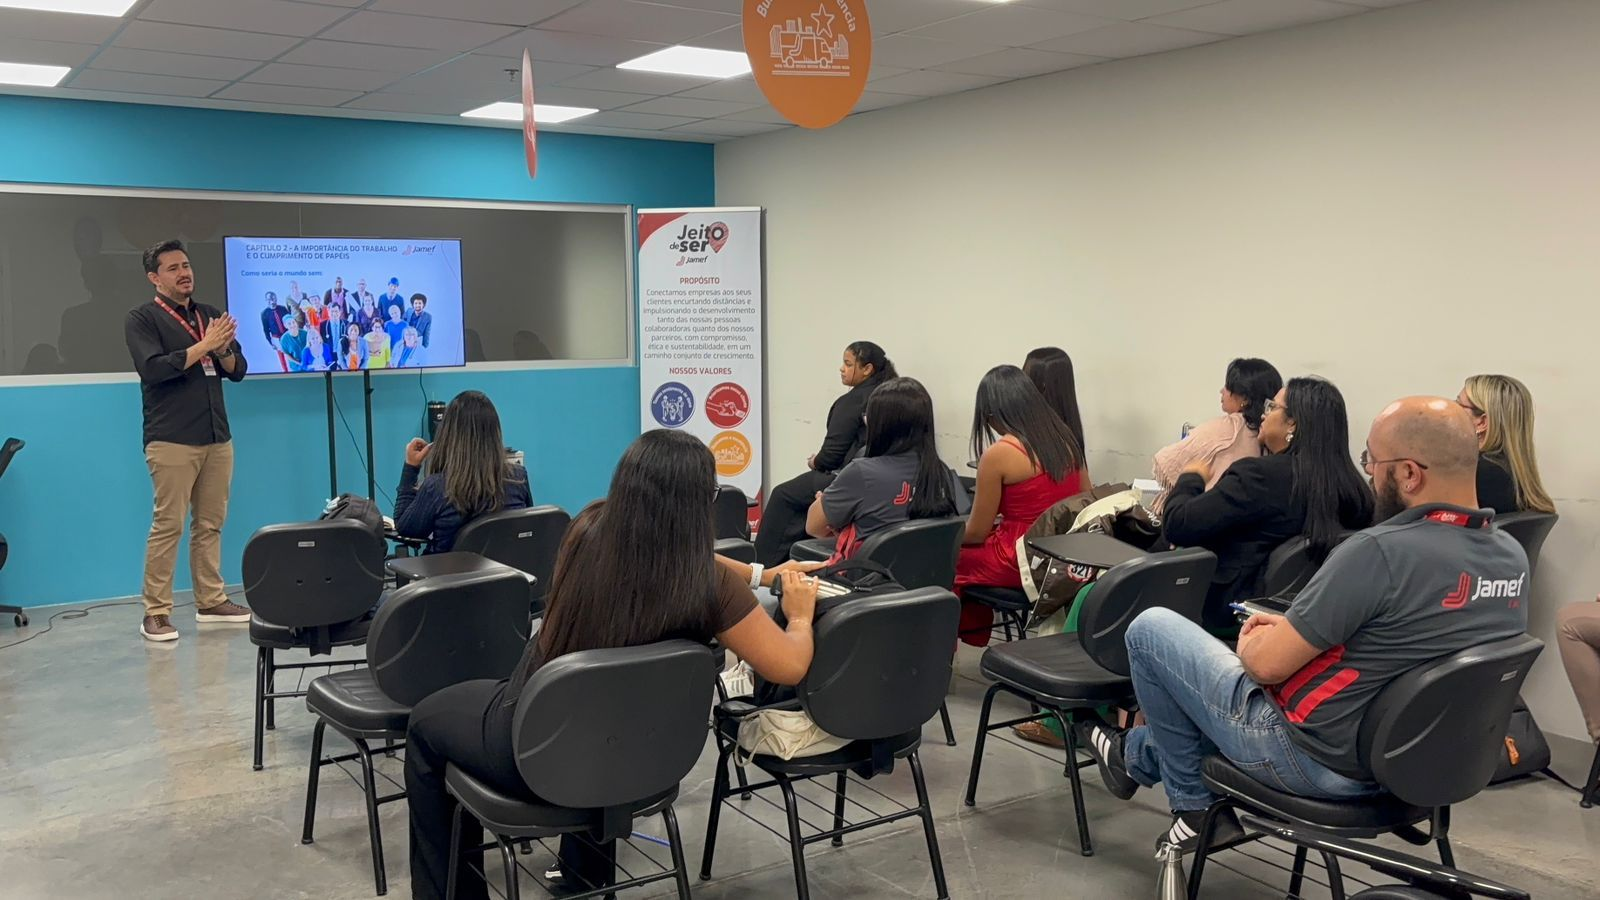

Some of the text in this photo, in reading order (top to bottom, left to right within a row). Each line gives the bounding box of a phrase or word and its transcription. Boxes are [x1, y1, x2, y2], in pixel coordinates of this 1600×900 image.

[246, 243, 281, 252] CAPÍTULO
[301, 243, 349, 252] IMPORTÂNCIA
[362, 245, 398, 253] TRABALHO
[412, 245, 437, 254] jamef
[669, 240, 710, 253] de ser
[260, 252, 313, 260] CUMPRIMENTO
[325, 251, 350, 260] PAPÉIS
[685, 255, 709, 264] jamef
[680, 276, 720, 285] PROPÓSITO
[646, 288, 687, 296] Conectamos
[688, 289, 721, 298] empresas
[712, 297, 746, 305] distâncias
[643, 307, 692, 315] impulsionando
[698, 306, 756, 314] desenvolvimento
[713, 317, 741, 325] pessoas
[644, 325, 691, 333] colaboradoras
[692, 325, 716, 335] quanto
[700, 334, 748, 343] compromisso,
[670, 343, 726, 351] sustentabilidade,
[673, 352, 702, 361] conjunto
[669, 367, 732, 375] NOSSOS VALORES
[1471, 572, 1526, 602] jamef
